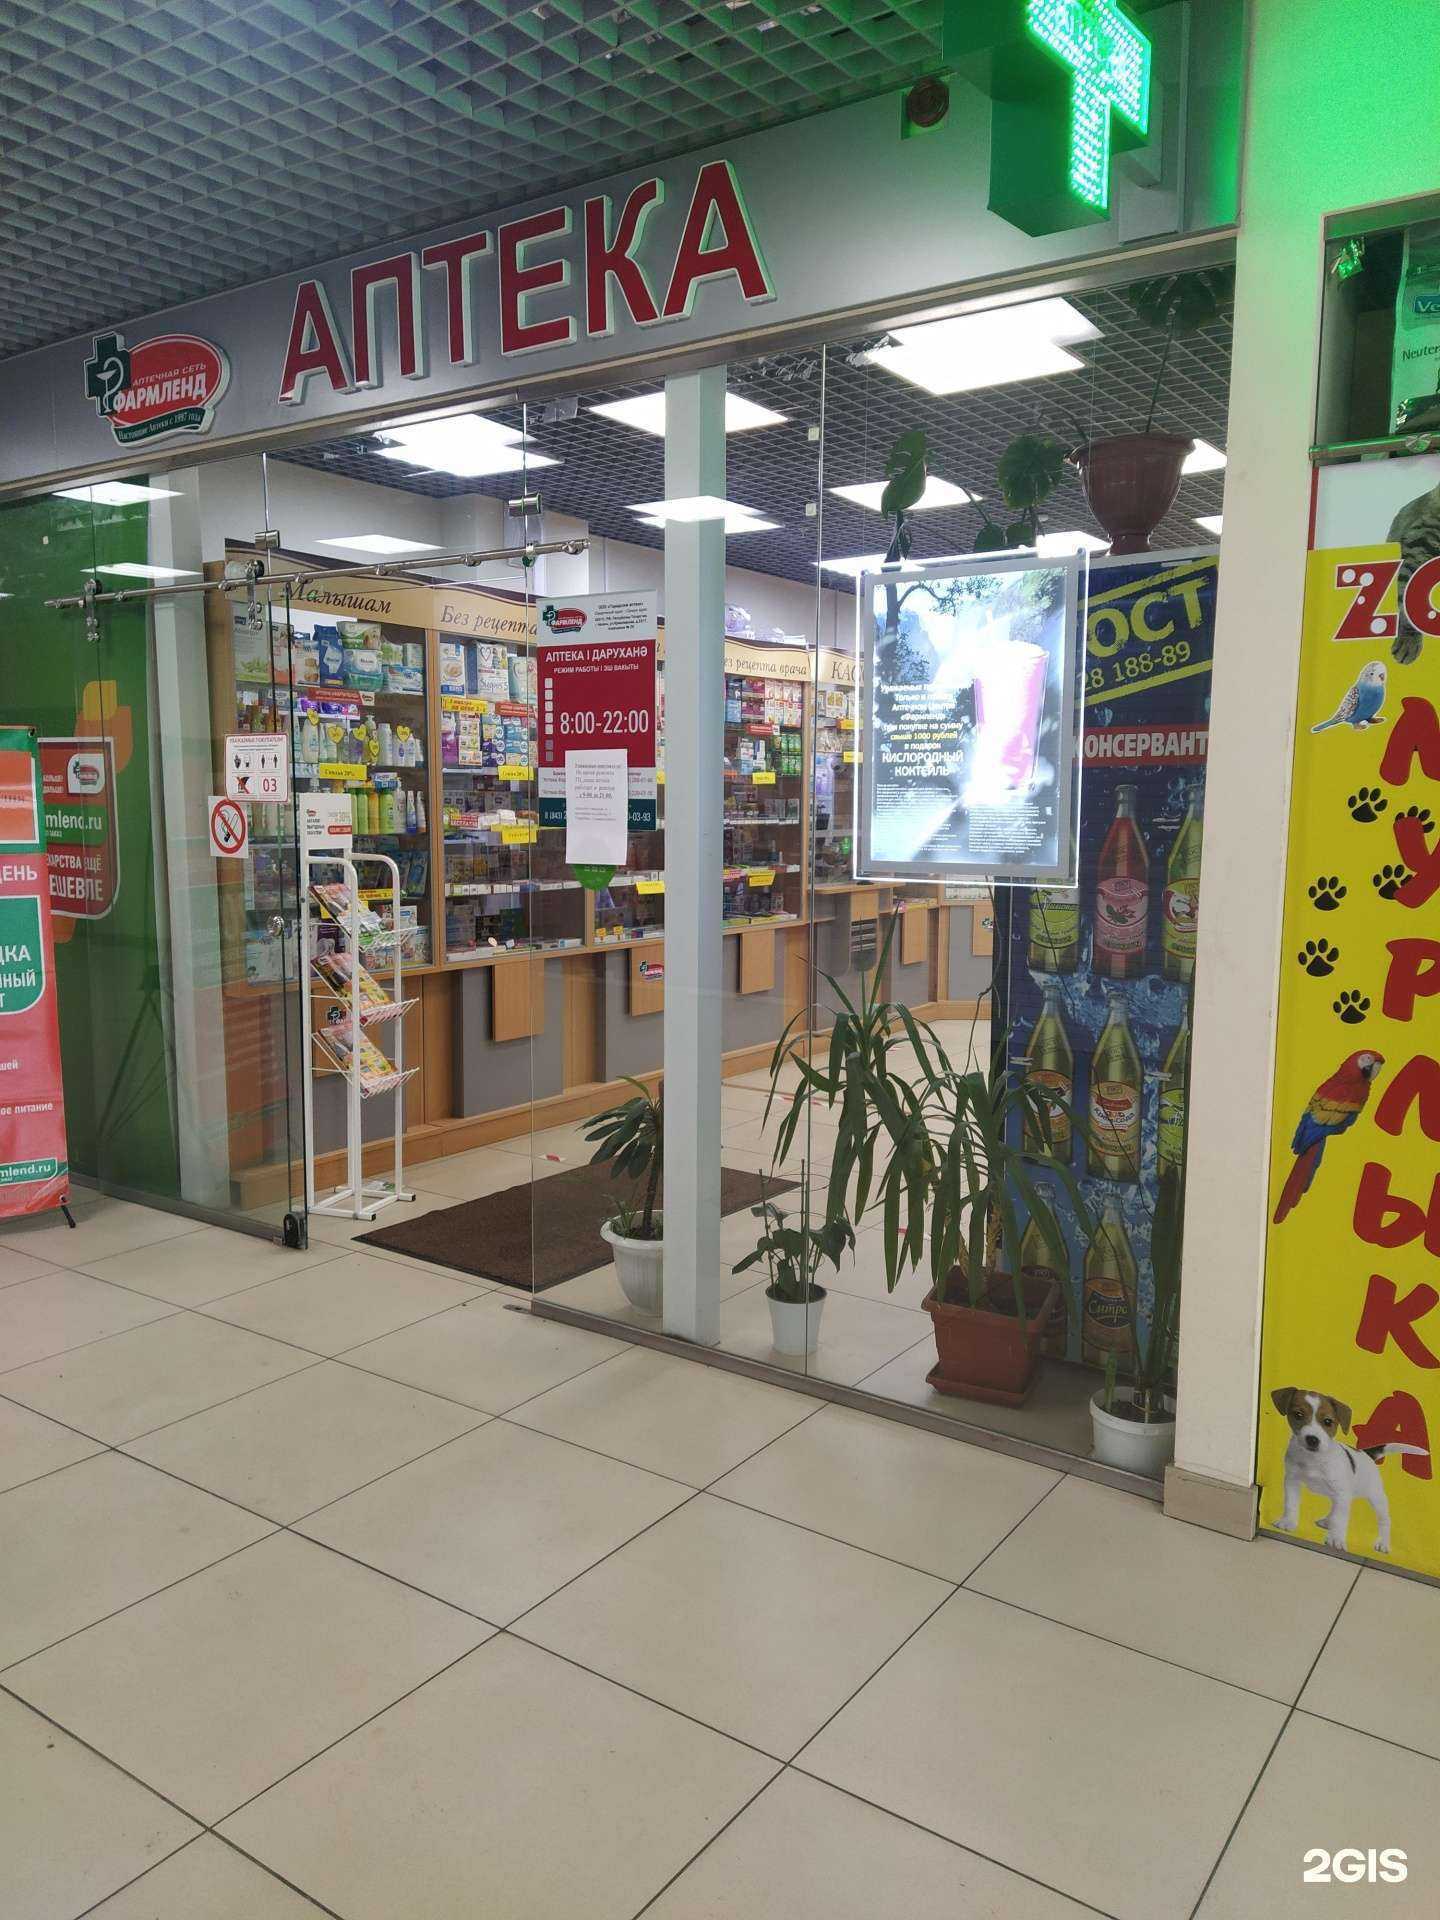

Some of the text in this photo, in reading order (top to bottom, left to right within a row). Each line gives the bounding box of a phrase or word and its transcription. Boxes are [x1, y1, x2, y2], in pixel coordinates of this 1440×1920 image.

[279, 160, 776, 405] АПТЕКА
[133, 363, 207, 386] АПТЕЧНАЯ СЕТЬ
[113, 372, 207, 413] ФАРМЛЕНД
[280, 580, 392, 614] Малышам
[440, 605, 537, 638] Без рецепта
[1087, 576, 1210, 657] ОСТ
[545, 646, 648, 663] АПТЕКА ДАРУХАНӘ
[1112, 641, 1191, 683] 188-89
[553, 666, 575, 674] РЕЖИМ
[575, 665, 600, 673] РАБОТЫ
[560, 709, 649, 735] 8:00-22:00
[932, 731, 957, 740] рублей
[882, 749, 964, 763] КИСЛОРОДНЫЙ
[894, 764, 950, 777] КОКТЕЙЛЬ
[262, 778, 277, 792] 03
[628, 812, 651, 821] -03-93
[0, 864, 38, 884] ЕНЬ
[49, 874, 103, 901] ЕШЕВЛЕ
[0, 945, 32, 966] КА
[14, 1102, 53, 1115] питание
